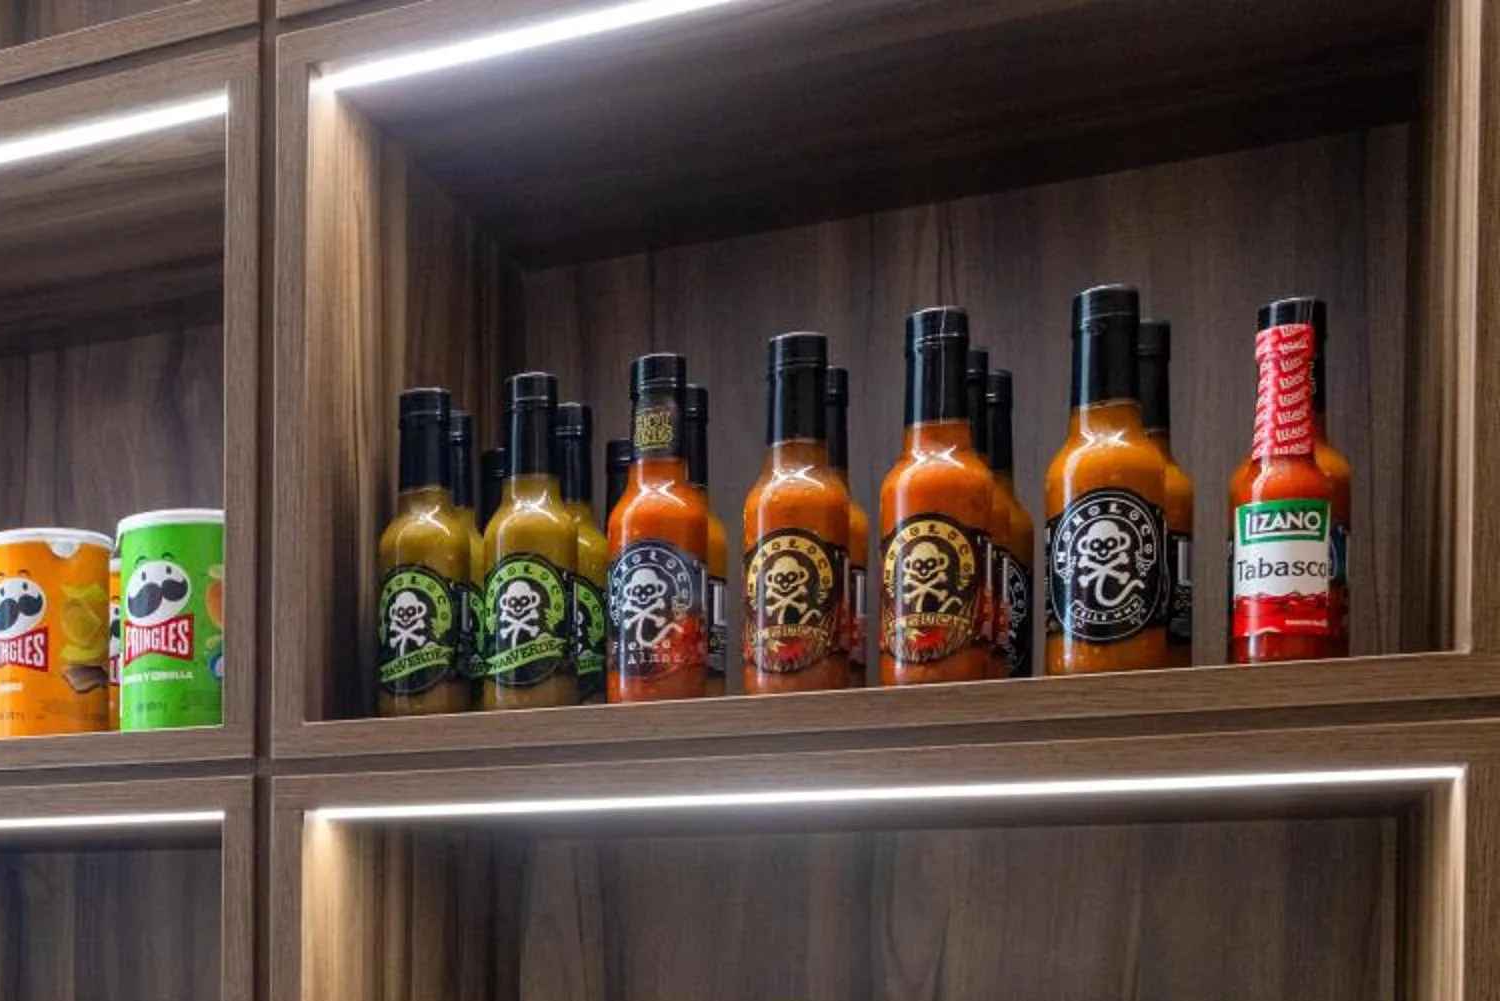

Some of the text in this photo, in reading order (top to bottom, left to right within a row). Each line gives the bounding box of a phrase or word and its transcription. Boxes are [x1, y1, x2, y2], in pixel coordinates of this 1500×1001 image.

[1245, 510, 1321, 541] LIZANO
[1237, 557, 1329, 582] Tabasco
[125, 618, 189, 661] PRINGLES
